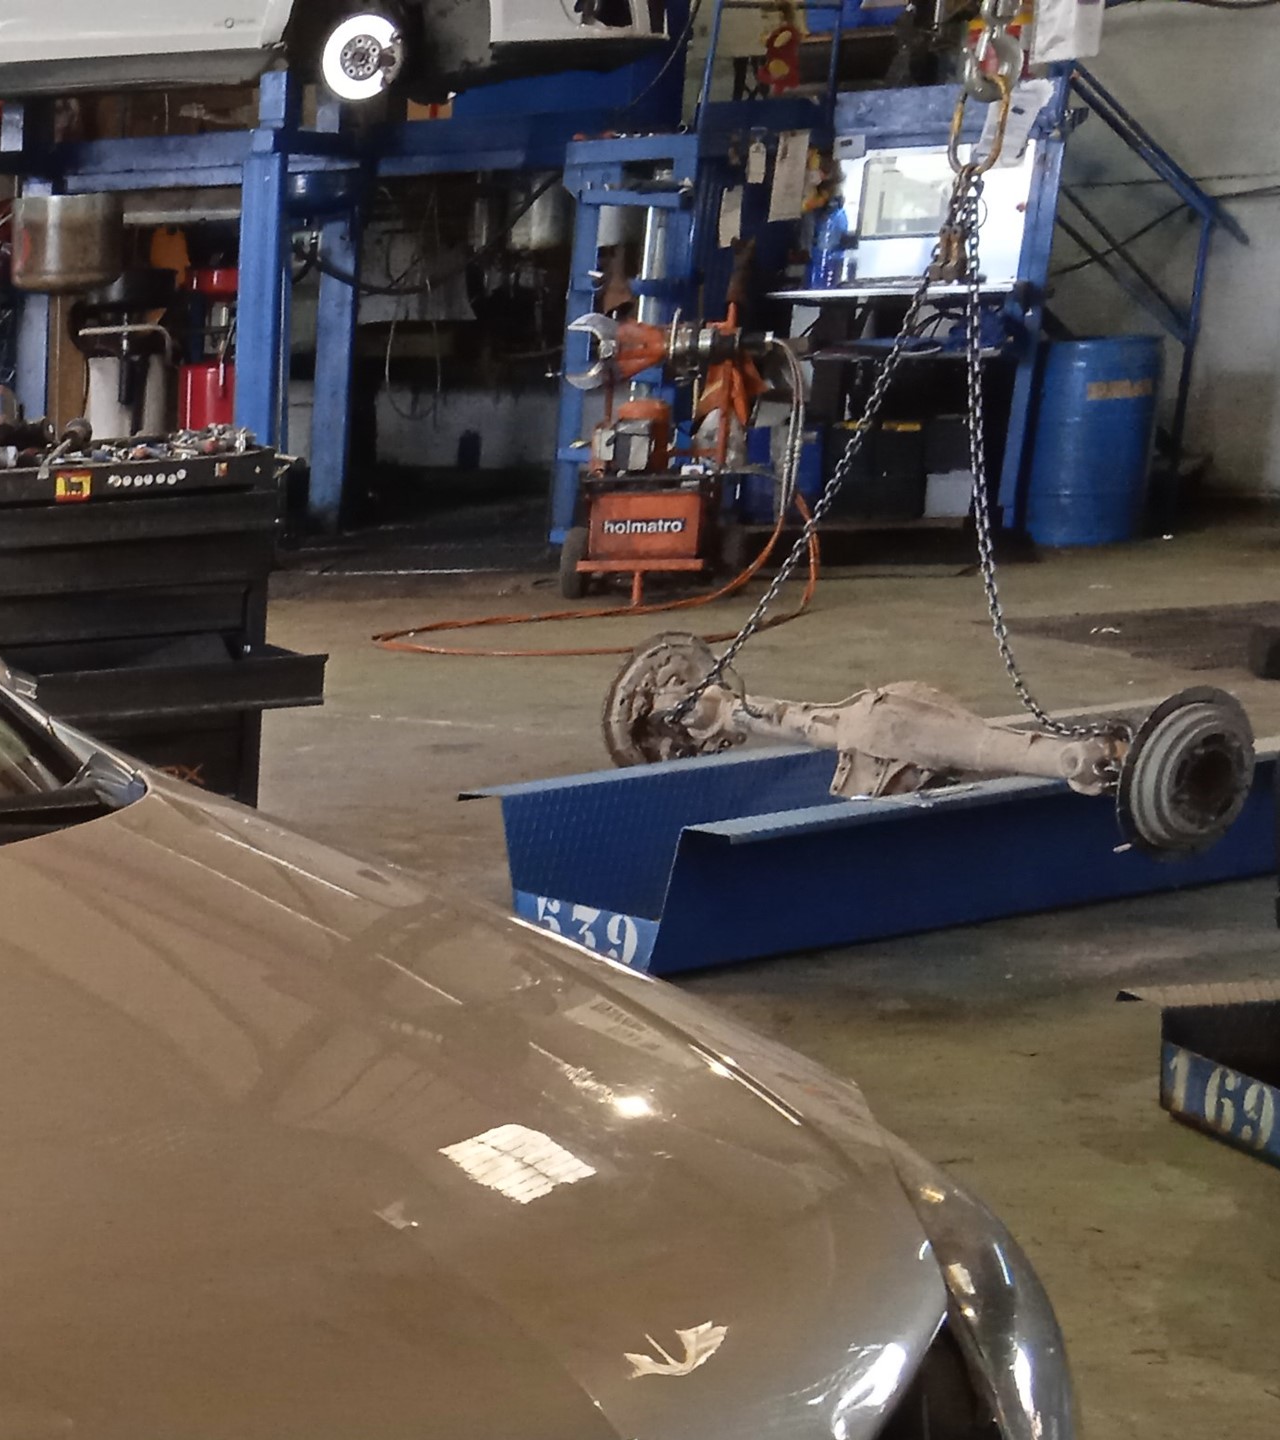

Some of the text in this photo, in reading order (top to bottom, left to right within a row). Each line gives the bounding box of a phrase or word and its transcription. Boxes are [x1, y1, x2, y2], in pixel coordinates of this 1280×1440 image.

[603, 519, 683, 534] holmatro
[537, 896, 638, 964] 539
[1169, 1048, 1274, 1151] 169
